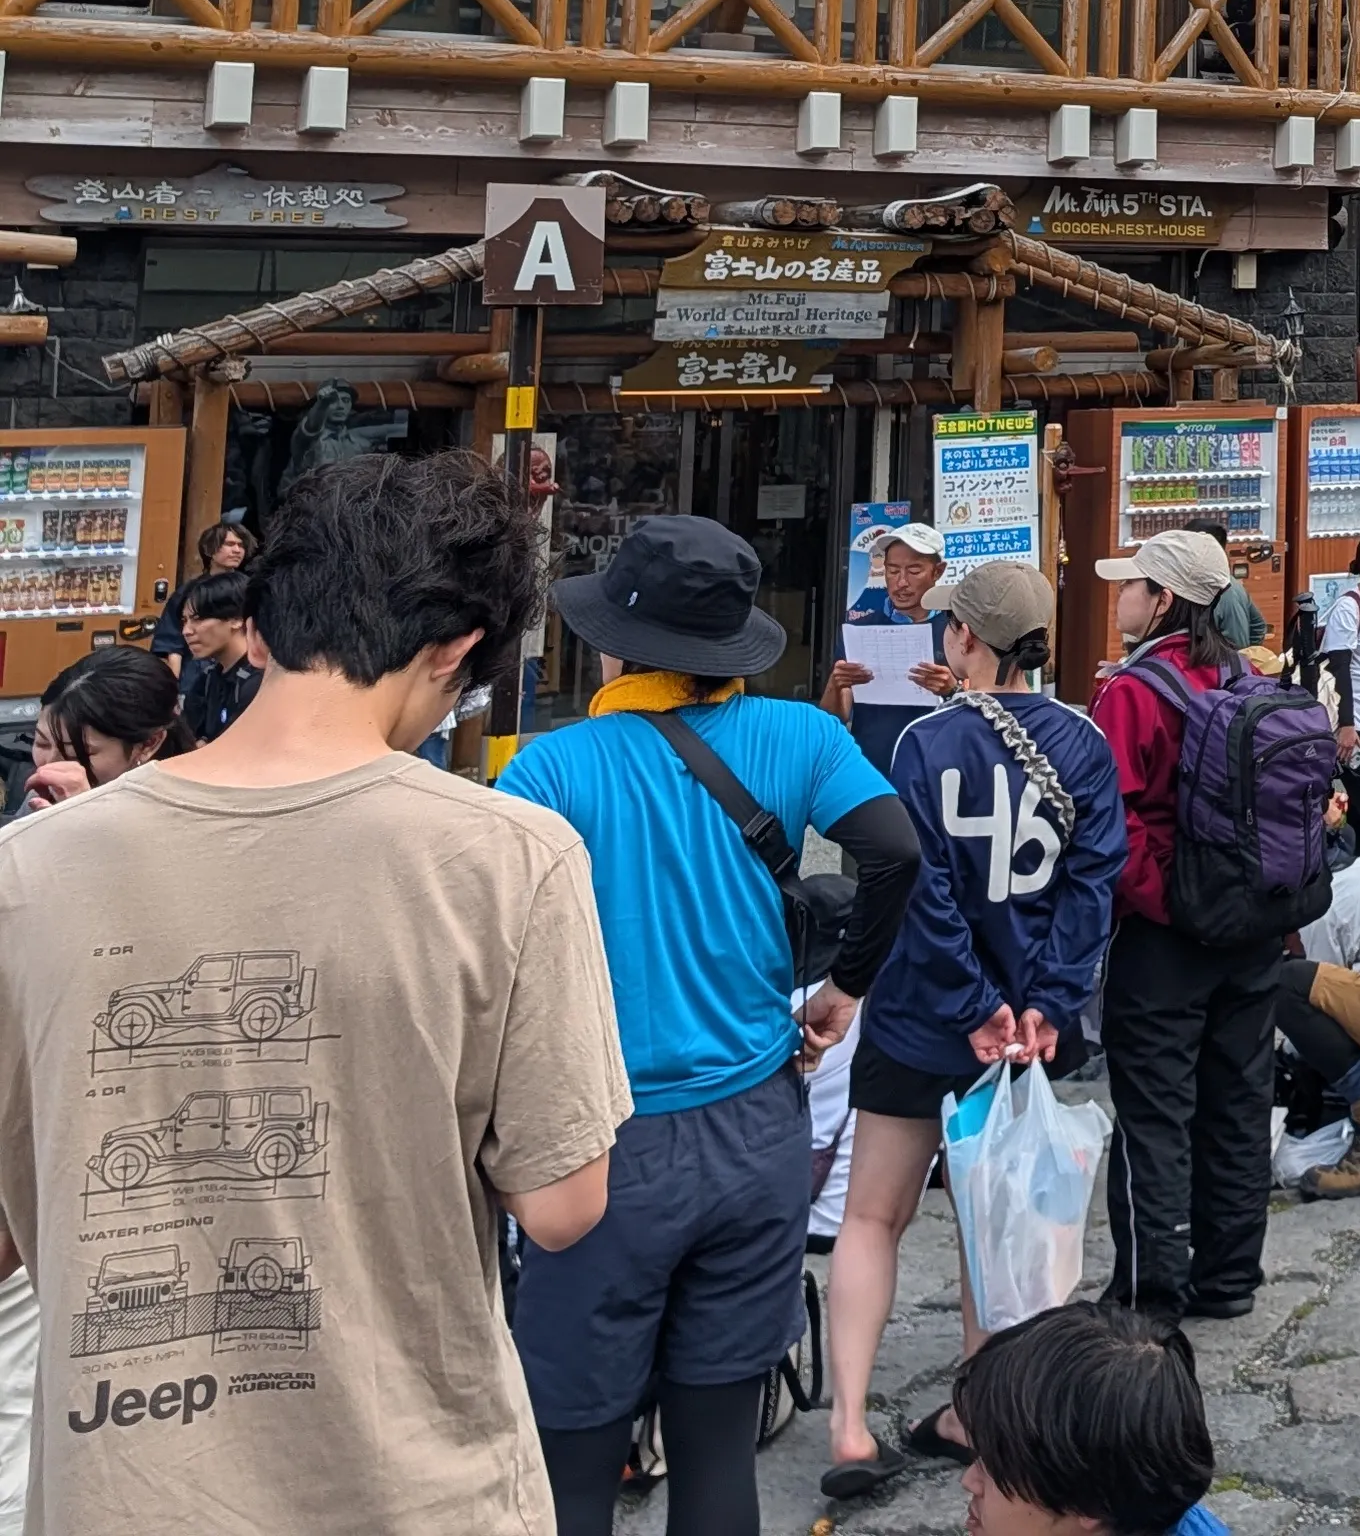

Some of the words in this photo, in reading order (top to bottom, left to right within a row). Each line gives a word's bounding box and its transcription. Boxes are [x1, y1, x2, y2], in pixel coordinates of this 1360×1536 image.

[1159, 195, 1212, 217] STA.
[140, 207, 221, 221] REST
[250, 210, 326, 224] FREE
[1051, 221, 1206, 237] GOGOEN-REST-HOUSE
[721, 235, 811, 250] 登山おみやげ
[513, 221, 576, 291] A
[704, 249, 882, 283] 富士山の名産品
[747, 293, 807, 307] Mt.Fuji
[677, 308, 728, 322] World
[732, 307, 800, 322] Cultural
[805, 308, 873, 322] Heritage
[723, 324, 828, 337] 富士山世界文化遺産
[677, 351, 796, 386] 富士登山
[943, 447, 1018, 460] 水のない富士山で
[945, 477, 1028, 492] コインシャワー
[946, 531, 1019, 545] 水のない富士山で
[941, 764, 1061, 902] 46
[93, 947, 104, 957] 2
[109, 945, 134, 955] DR
[85, 1088, 96, 1098] 4
[102, 1086, 126, 1096] DR
[79, 1226, 139, 1243] WATER
[143, 1216, 214, 1234] FORDING
[123, 1357, 141, 1366] AT
[144, 1355, 152, 1364] 5
[155, 1350, 185, 1362] MPH
[229, 1372, 315, 1383] WRANGLER
[227, 1378, 316, 1396] RUBICON
[68, 1373, 218, 1433] Jeep
